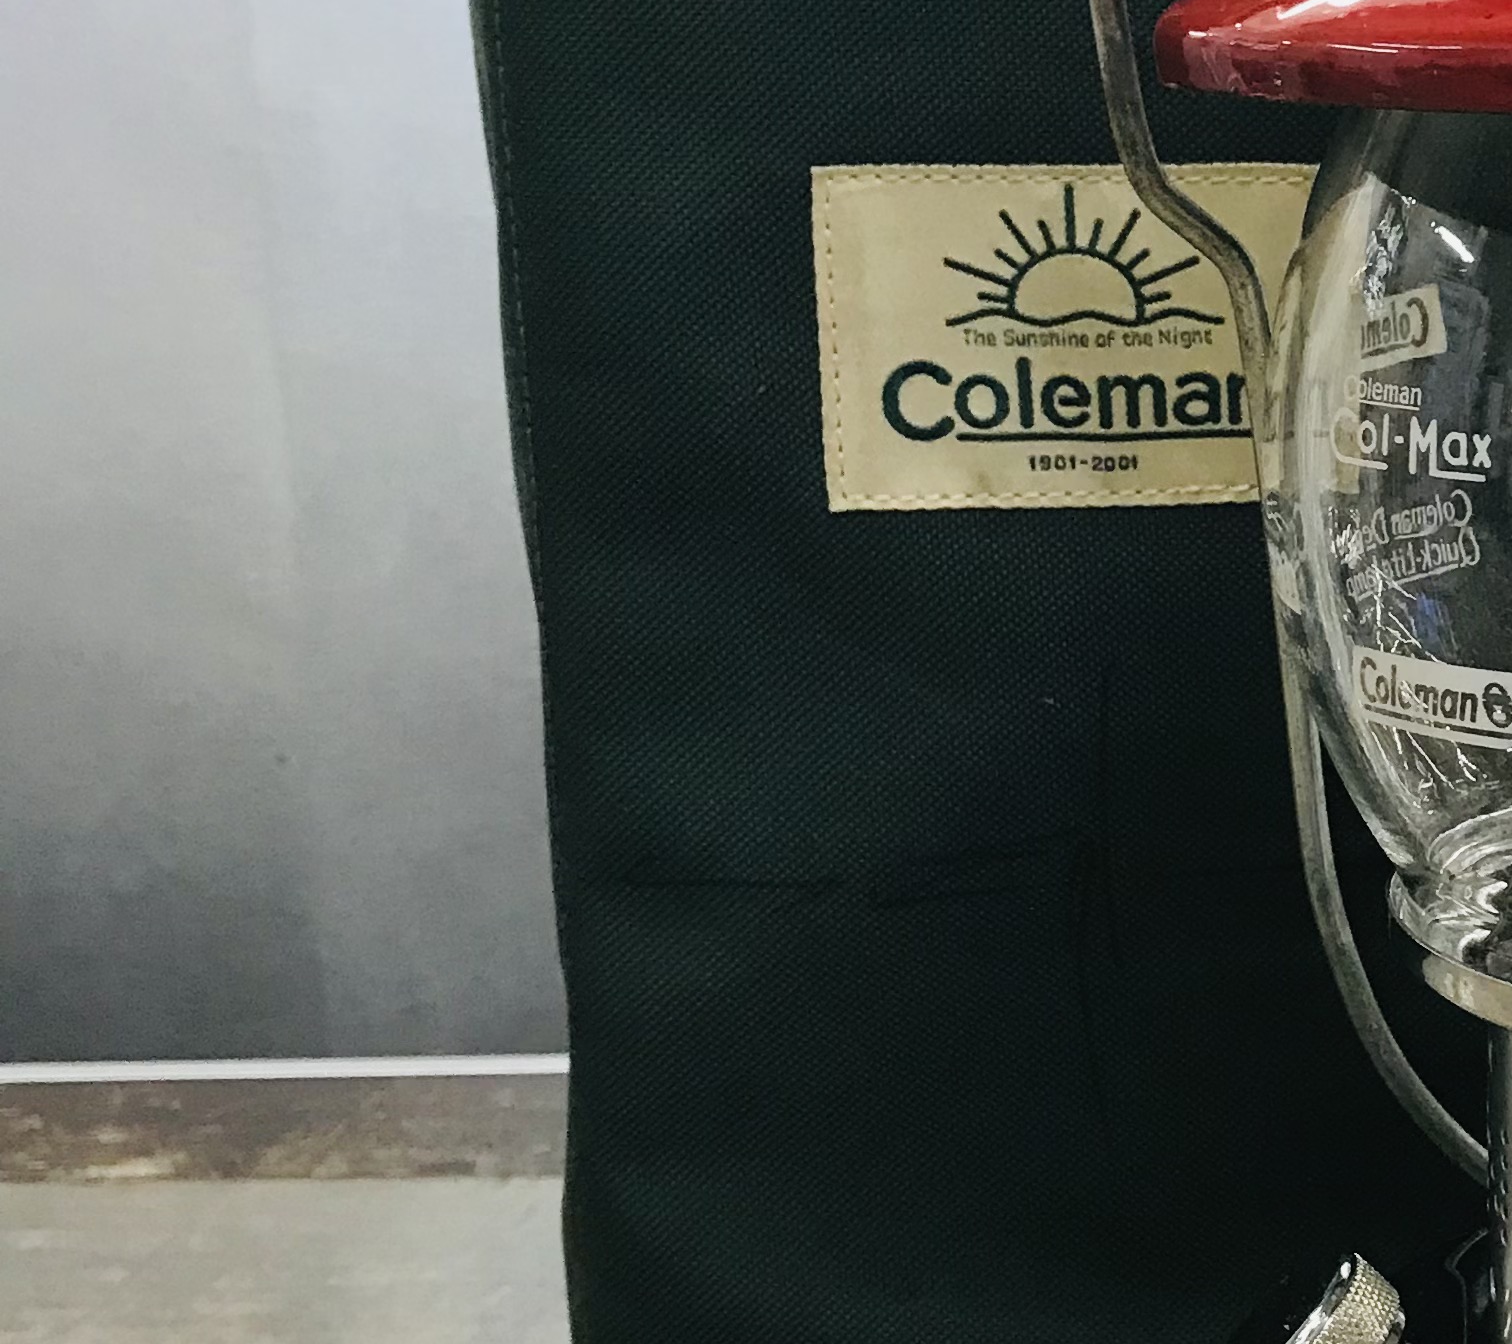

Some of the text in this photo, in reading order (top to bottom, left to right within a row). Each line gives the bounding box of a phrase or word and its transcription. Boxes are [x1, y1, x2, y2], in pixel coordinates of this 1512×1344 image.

[962, 327, 1214, 349] The Sunshine of the Night
[1343, 374, 1422, 408] Coleman
[1331, 407, 1493, 478] Col-Max
[1028, 454, 1140, 472] 1901-2001
[1360, 656, 1479, 724] Coleman
